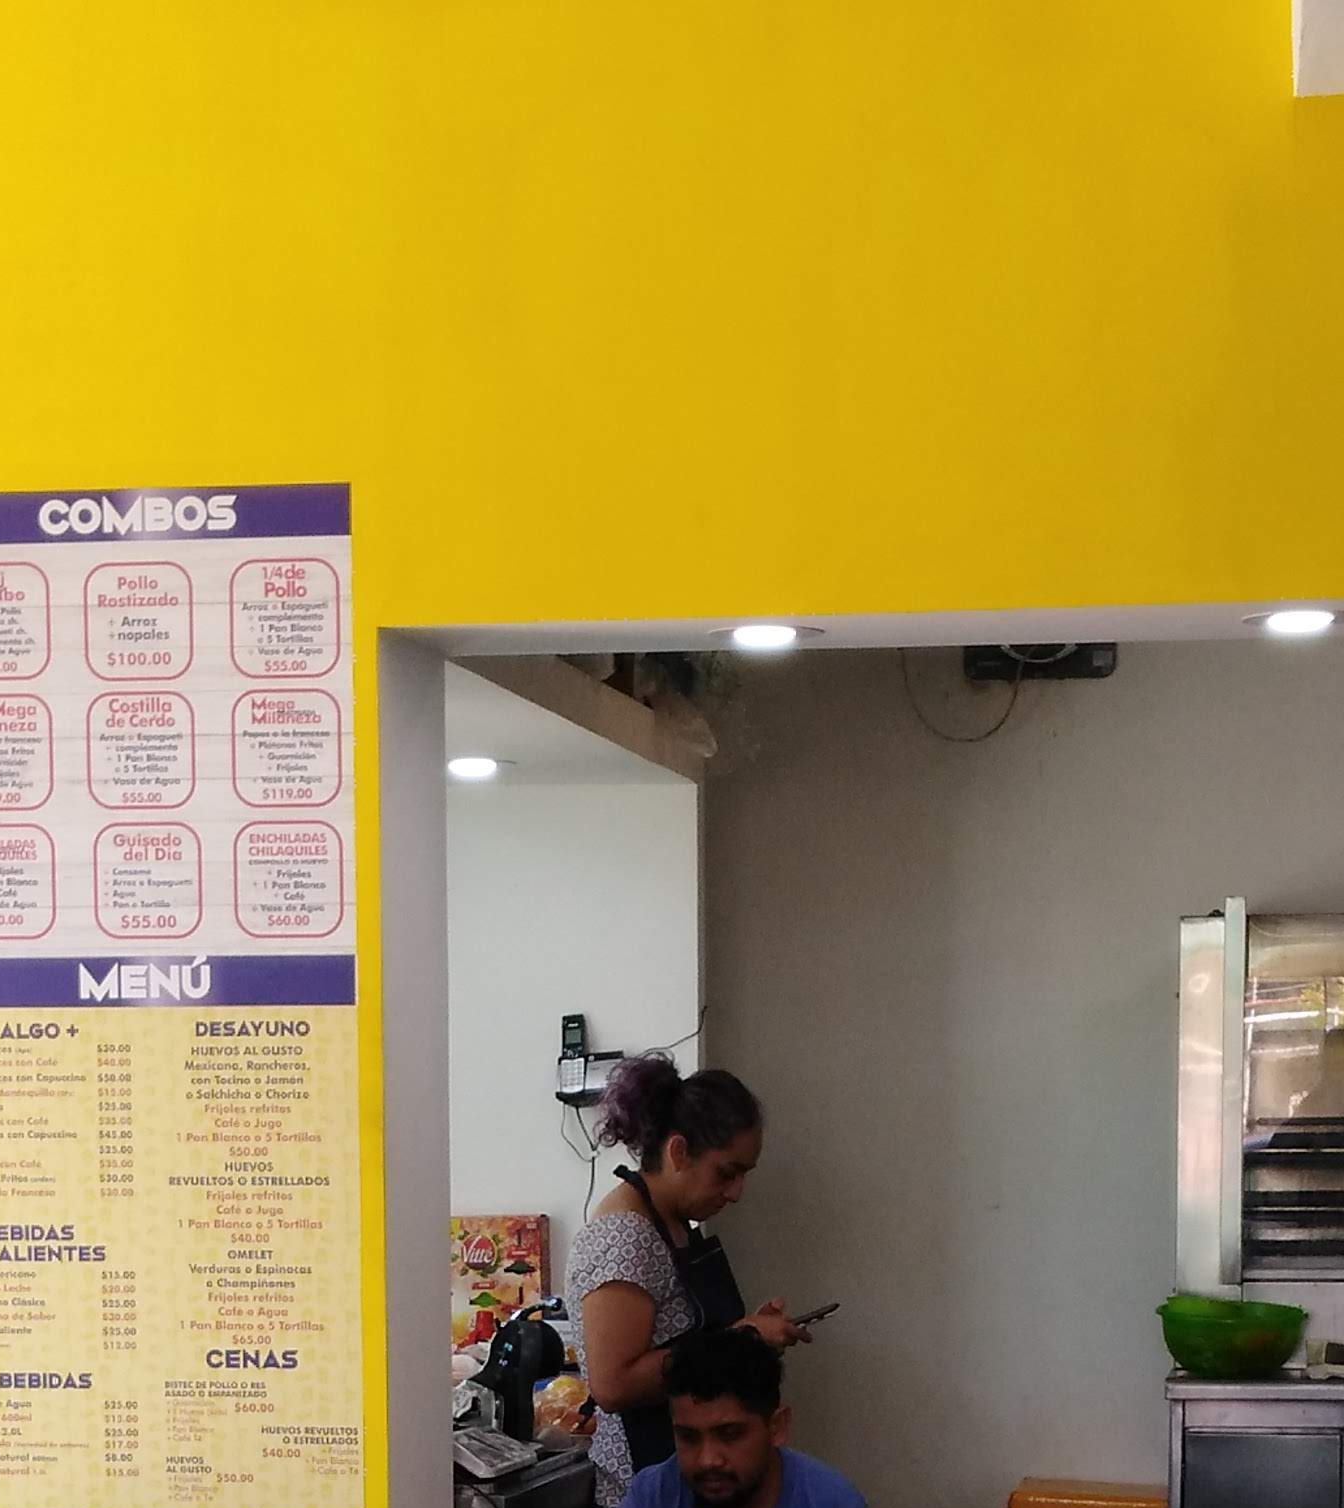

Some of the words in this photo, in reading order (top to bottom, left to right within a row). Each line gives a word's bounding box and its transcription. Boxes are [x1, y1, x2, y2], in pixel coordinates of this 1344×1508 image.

[39, 494, 238, 535] COMBOS
[118, 576, 158, 590] Pollo
[265, 581, 307, 597] Pollo
[98, 592, 179, 607] Rostizado
[121, 617, 158, 627] Arroz
[118, 629, 170, 642] nopales
[108, 652, 171, 666] $100.00
[109, 697, 172, 713] Costilla
[106, 714, 125, 727] de
[130, 713, 175, 727] Cerdo
[113, 833, 181, 847] Guisado
[249, 834, 327, 843] ENCHILADAS
[123, 848, 148, 860] del
[249, 846, 327, 856] CHILAQUILES
[121, 915, 176, 929] $55.00
[79, 954, 211, 1002] MENÚ
[0, 1022, 60, 1039] ALGO
[195, 1021, 310, 1037] DESAYUNO
[191, 1046, 239, 1056] HUEVOS
[243, 1046, 258, 1055] AL
[262, 1046, 303, 1056] GUSTO
[191, 1077, 210, 1085] con
[215, 1076, 251, 1085] Tocino
[196, 1089, 251, 1100] Salchicha
[224, 1162, 274, 1172] HUEVOS
[169, 1176, 233, 1186] REVUELTOS
[251, 1176, 330, 1186] ESTRELLADOS
[228, 1250, 274, 1260] OMELET
[206, 1349, 298, 1369] CENAS
[0, 1372, 92, 1389] BEBIDAS
